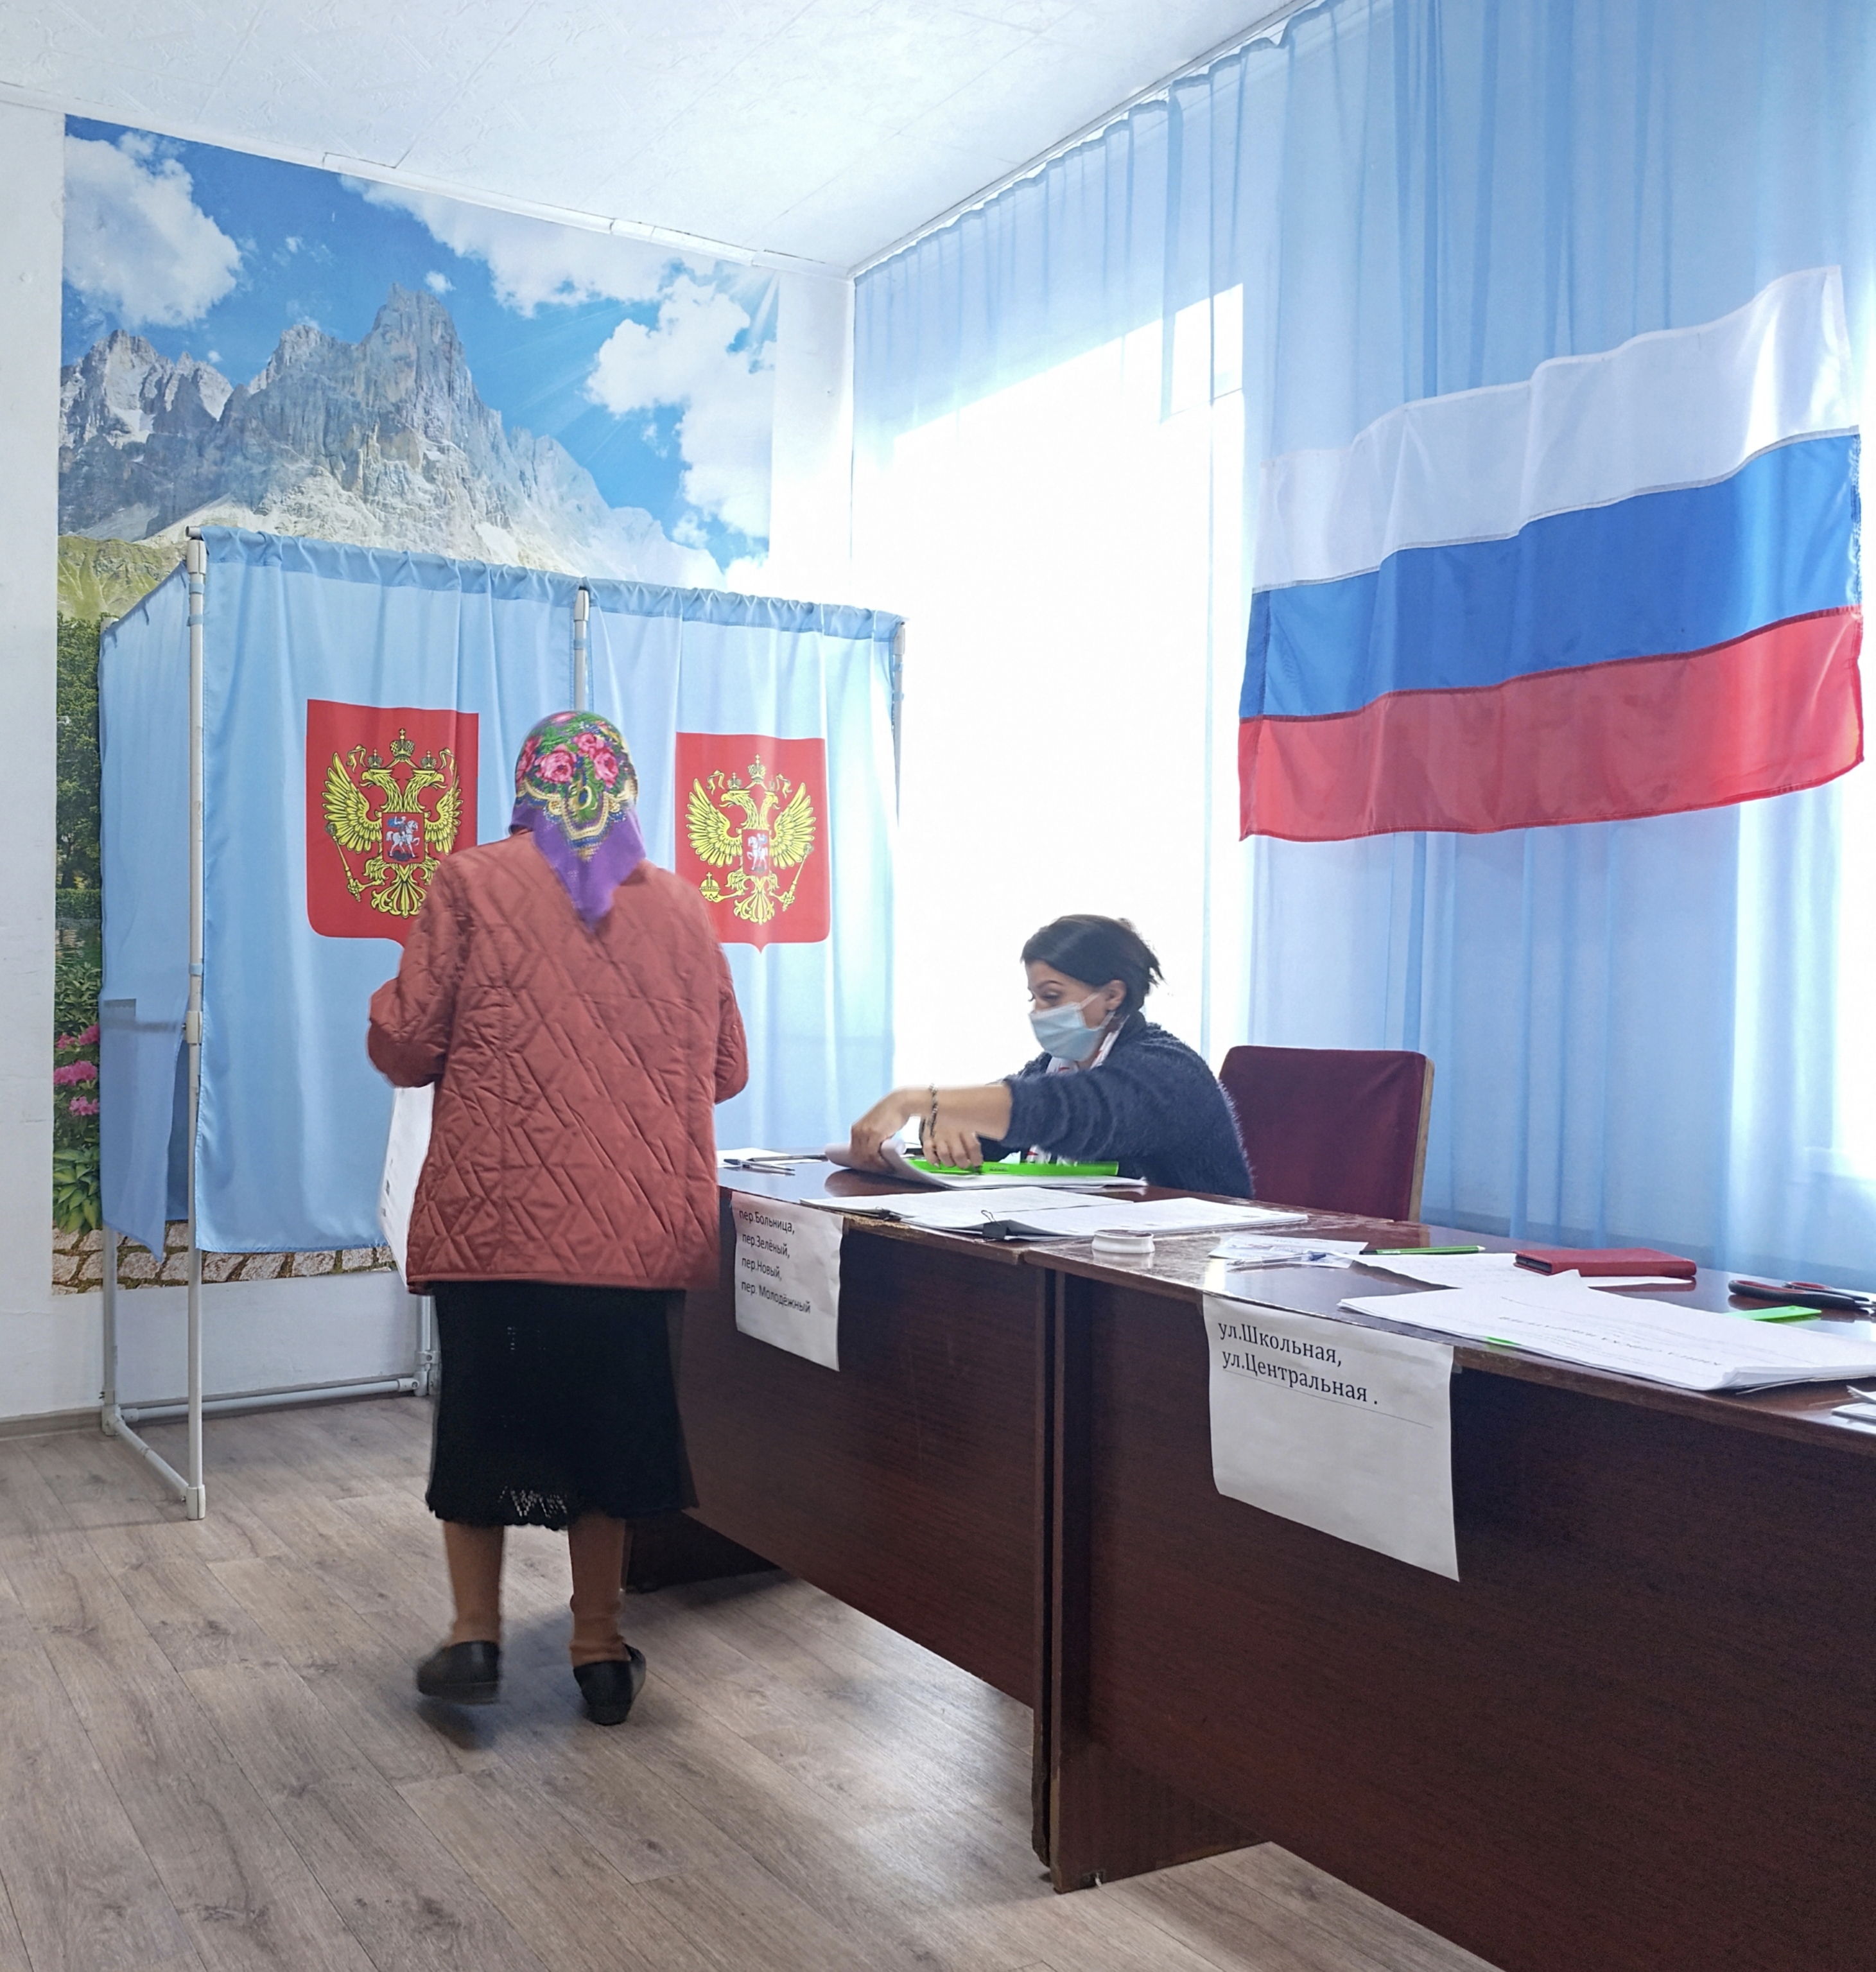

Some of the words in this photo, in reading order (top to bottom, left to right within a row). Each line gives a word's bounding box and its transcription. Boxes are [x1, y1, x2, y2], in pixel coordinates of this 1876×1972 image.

[739, 1209, 795, 1235] пер.Больница,
[742, 1233, 790, 1259] пер.Зелёный,
[742, 1256, 782, 1282] пер.Новый,
[759, 1285, 811, 1314] Молодёжный
[1218, 1322, 1342, 1367] ул.Школьная,
